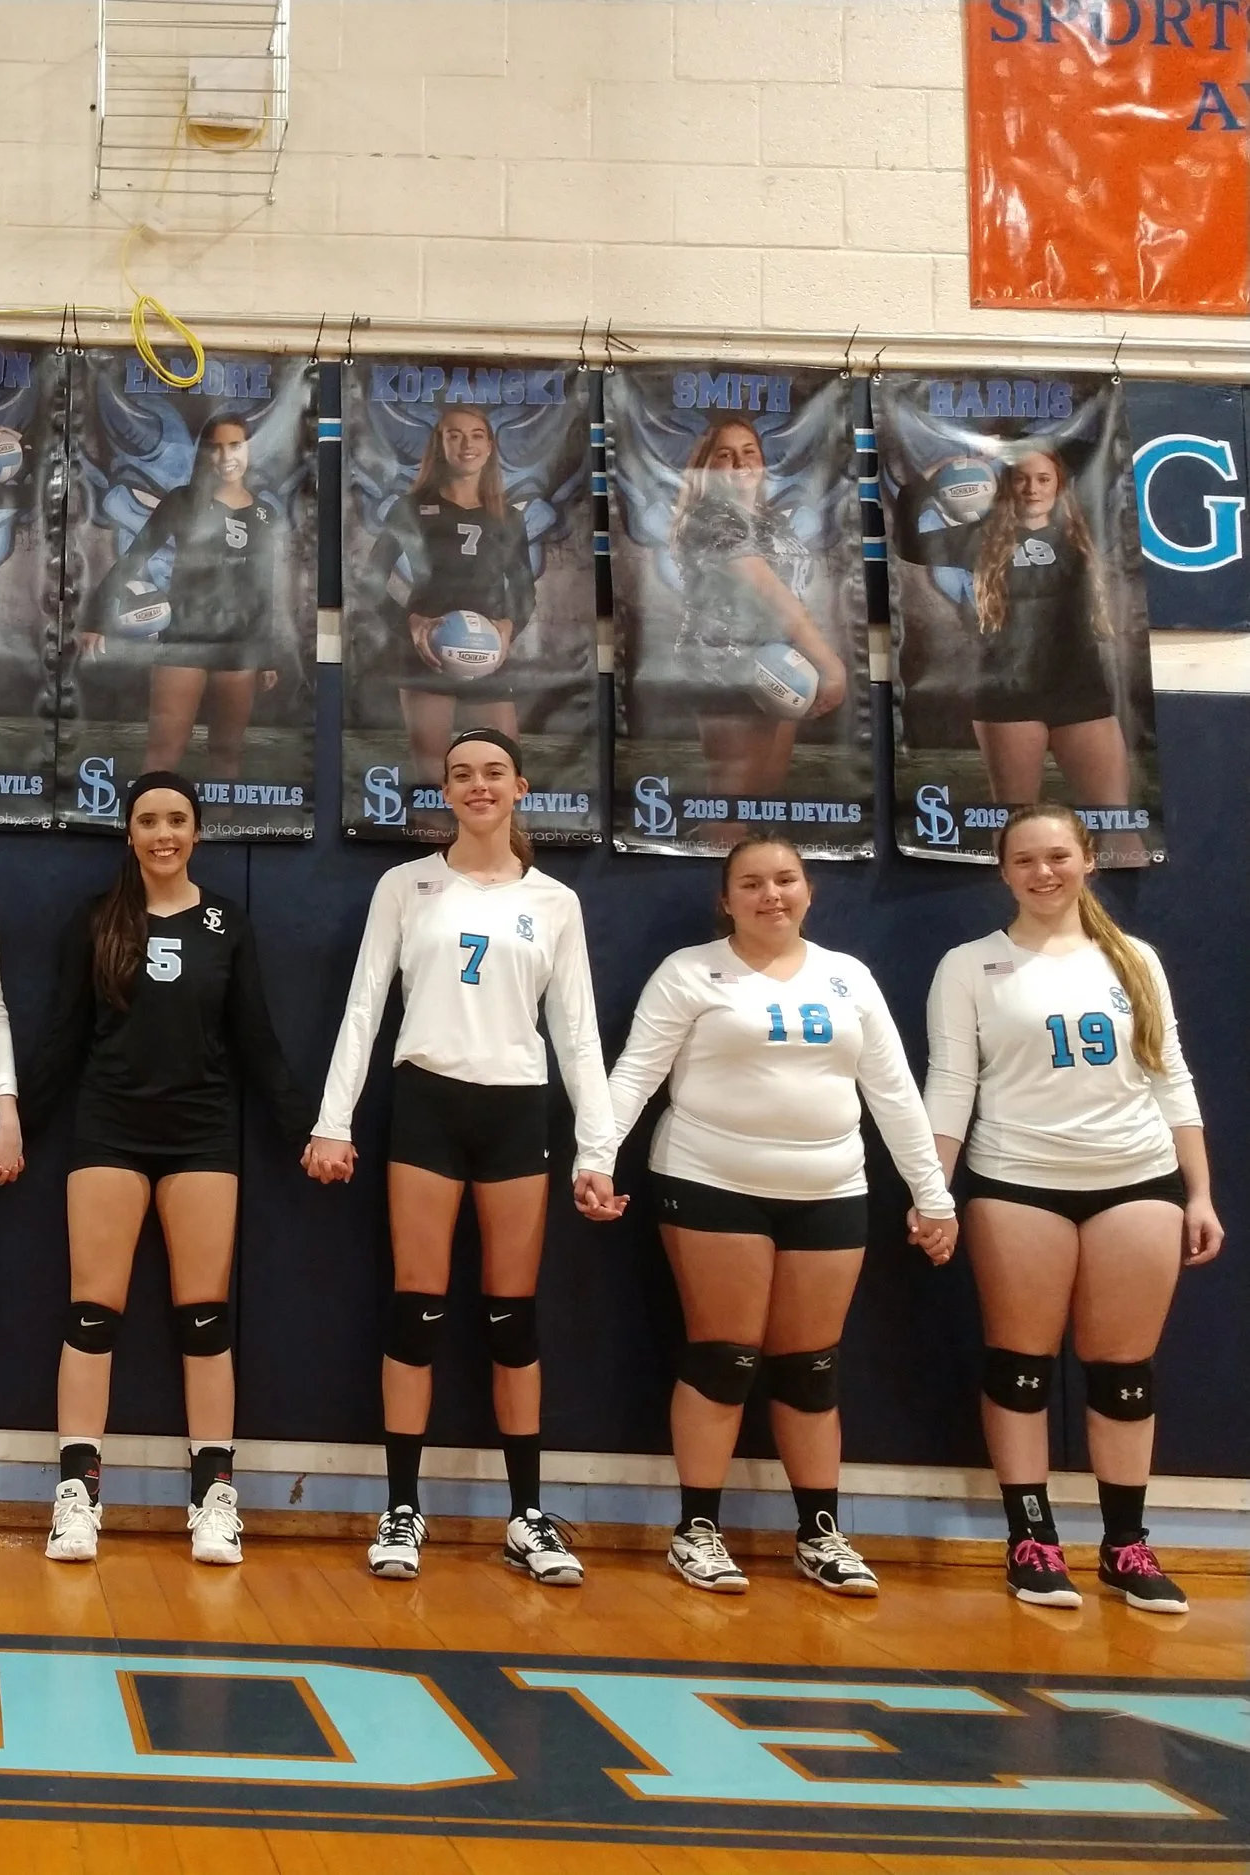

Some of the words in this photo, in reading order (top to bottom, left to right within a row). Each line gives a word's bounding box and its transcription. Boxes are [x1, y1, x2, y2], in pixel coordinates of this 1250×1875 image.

[990, 0, 1250, 50] SPORT
[1186, 81, 1250, 131] A
[123, 358, 272, 399] ELMORE
[370, 365, 566, 405] KOPANSKI
[672, 371, 793, 412] SMITH
[929, 381, 1073, 419] HARRIS
[225, 517, 248, 549] 5
[457, 523, 483, 555] 7
[234, 785, 304, 806] DEVILS
[413, 789, 453, 809] 201
[520, 793, 589, 813] DEVILS
[683, 799, 729, 819] 2019
[737, 800, 787, 821] BLUE
[791, 803, 861, 823] DEVILS
[964, 808, 1010, 828] 2019
[146, 937, 182, 982] 5
[459, 932, 489, 985] 7
[766, 1003, 833, 1044] 18
[1045, 1012, 1118, 1068] 19
